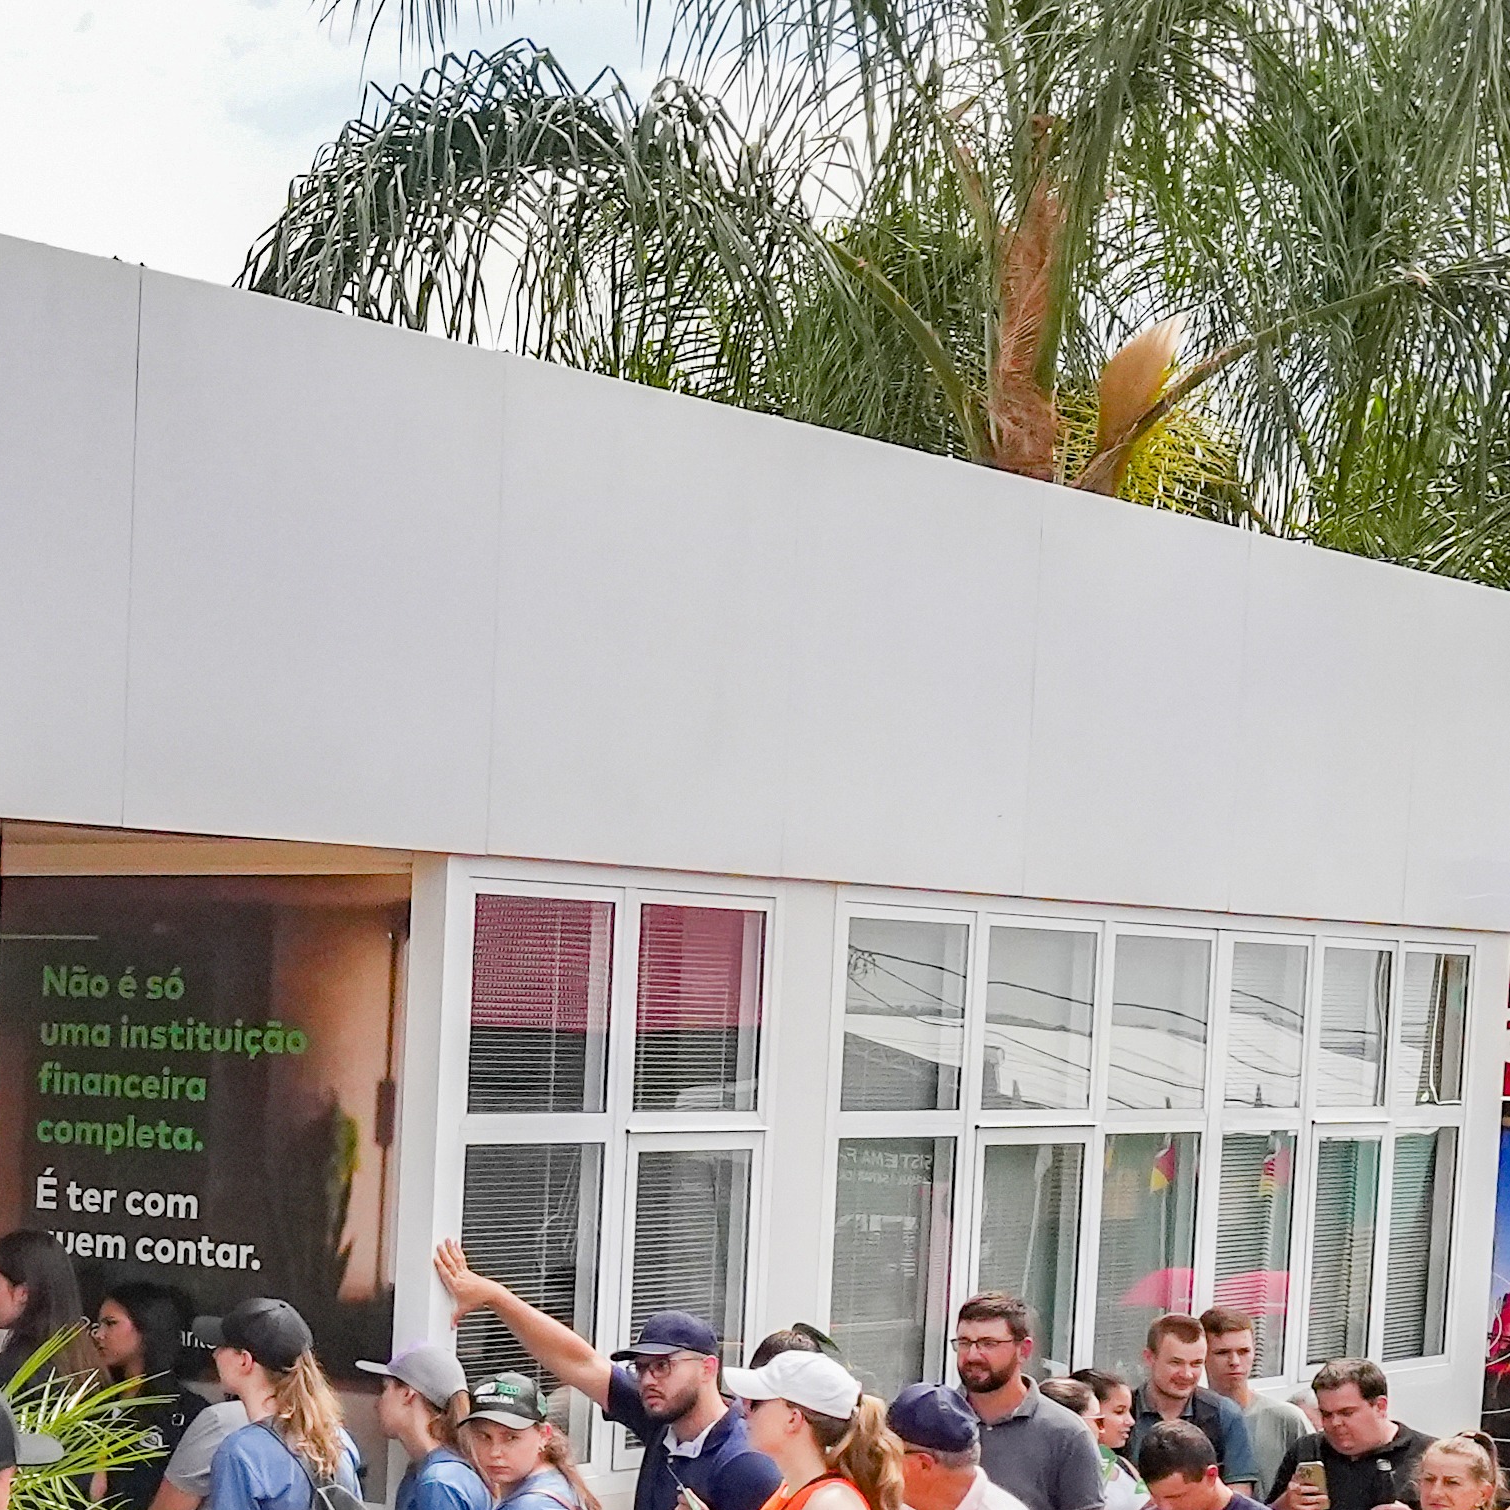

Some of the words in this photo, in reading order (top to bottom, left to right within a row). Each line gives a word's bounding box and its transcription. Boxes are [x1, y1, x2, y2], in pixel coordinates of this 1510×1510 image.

[41, 965, 110, 999] Não
[118, 966, 138, 999] é
[145, 967, 185, 1000] só
[40, 1021, 111, 1047] uma
[120, 1014, 308, 1060] instituição
[38, 1061, 207, 1101] financeira
[36, 1114, 204, 1154] completa.
[35, 1167, 58, 1210] É
[66, 1180, 117, 1214] ter
[125, 1191, 198, 1220] com
[47, 1230, 126, 1260] uem
[135, 1235, 261, 1271] contar.
